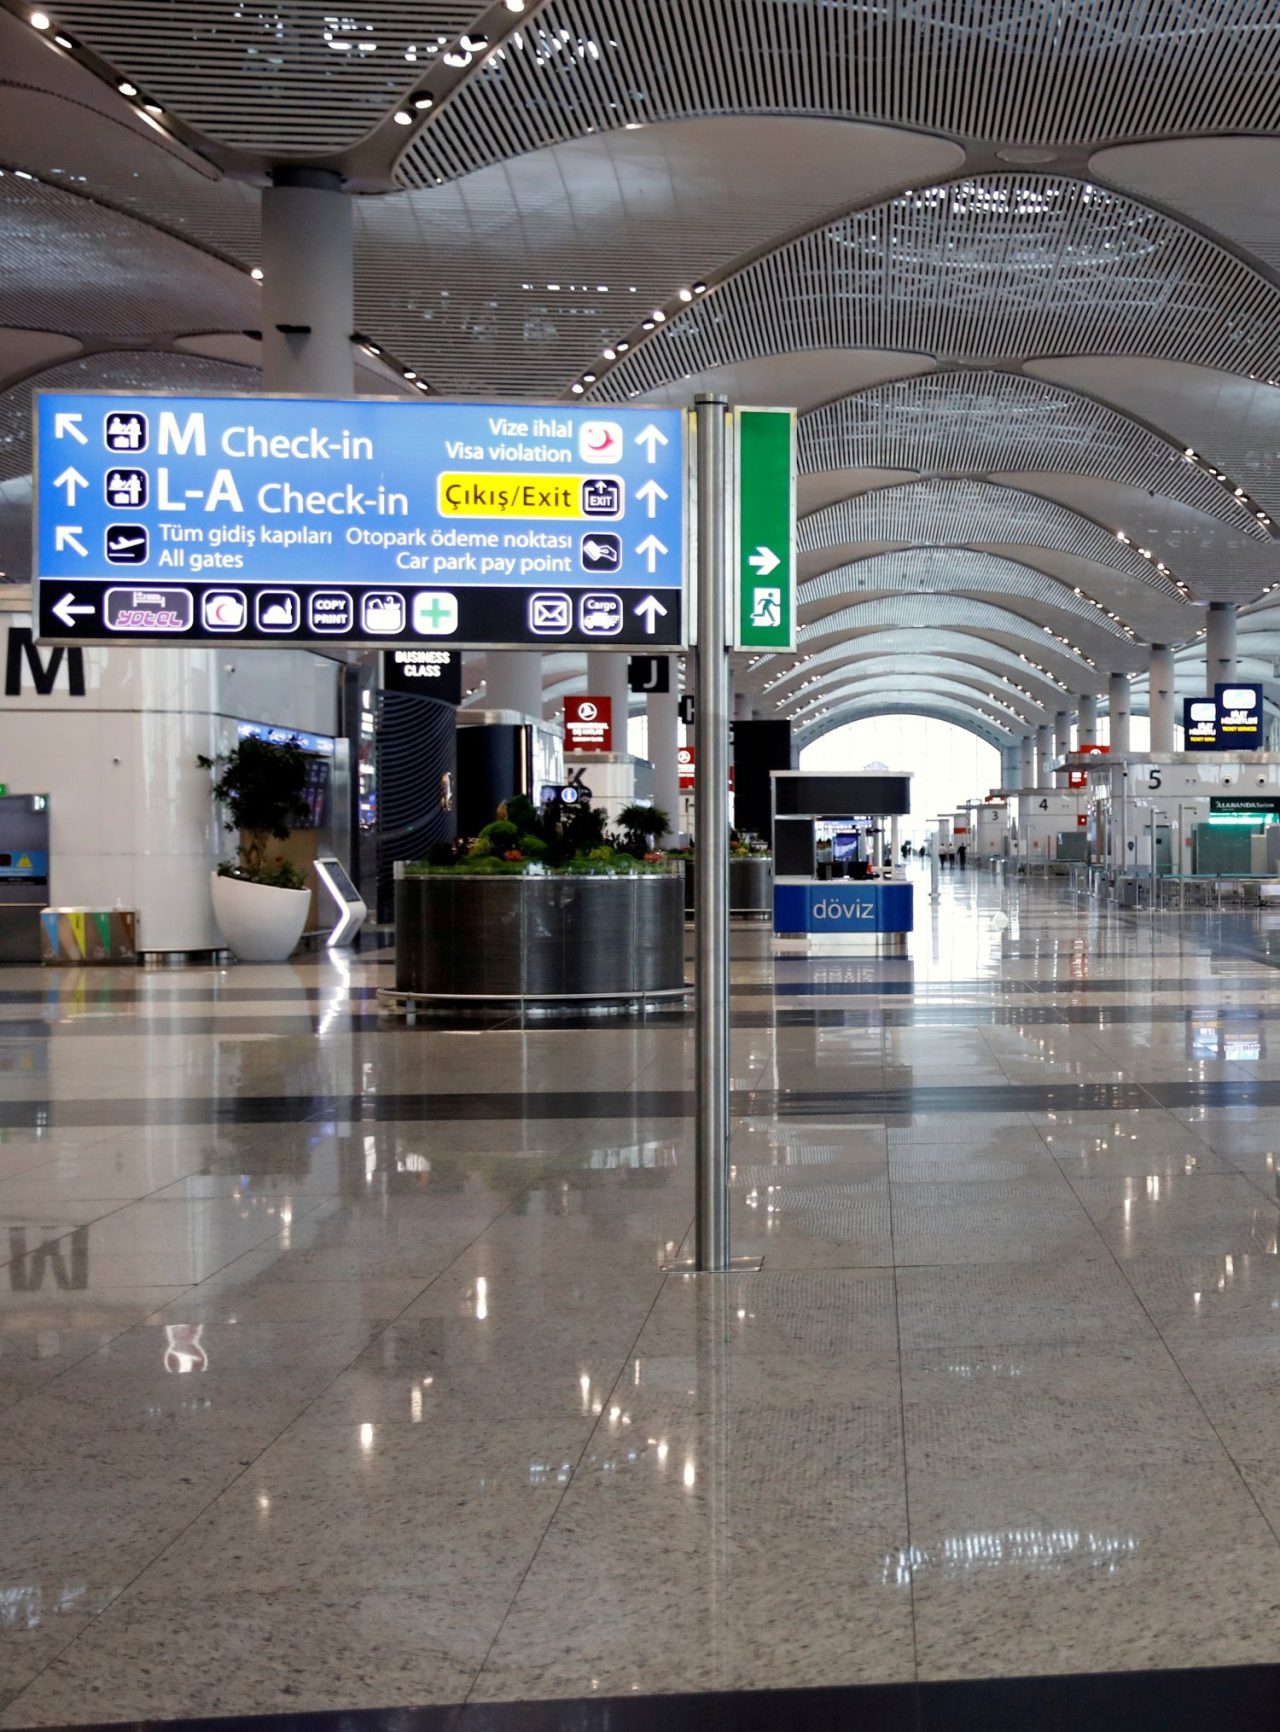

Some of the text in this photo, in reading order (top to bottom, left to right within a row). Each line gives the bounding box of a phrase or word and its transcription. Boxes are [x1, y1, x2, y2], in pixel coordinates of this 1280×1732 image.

[158, 412, 374, 459] M Check-in
[489, 418, 572, 438] Vize ihlal
[446, 442, 572, 463] Visa violation
[158, 468, 408, 516] L-A Check-in
[445, 484, 571, 511] Çıkış/Exit
[590, 496, 613, 507] EXIT
[158, 523, 332, 549] Tüm gidiş kapıları
[346, 528, 572, 550] Otopark ödeme noktası
[158, 550, 244, 572] All gates
[396, 552, 572, 577] Car park pay point
[315, 599, 346, 611] COPY
[587, 600, 617, 612] Cargo
[313, 613, 347, 626] PRINT
[5, 628, 86, 696] M
[395, 651, 451, 664] BUSINESS
[404, 665, 441, 677] CLASS
[643, 660, 657, 688] J
[1148, 770, 1162, 789] 5
[1039, 799, 1048, 811] 4
[992, 811, 999, 820] 3
[813, 899, 875, 919] döviz
